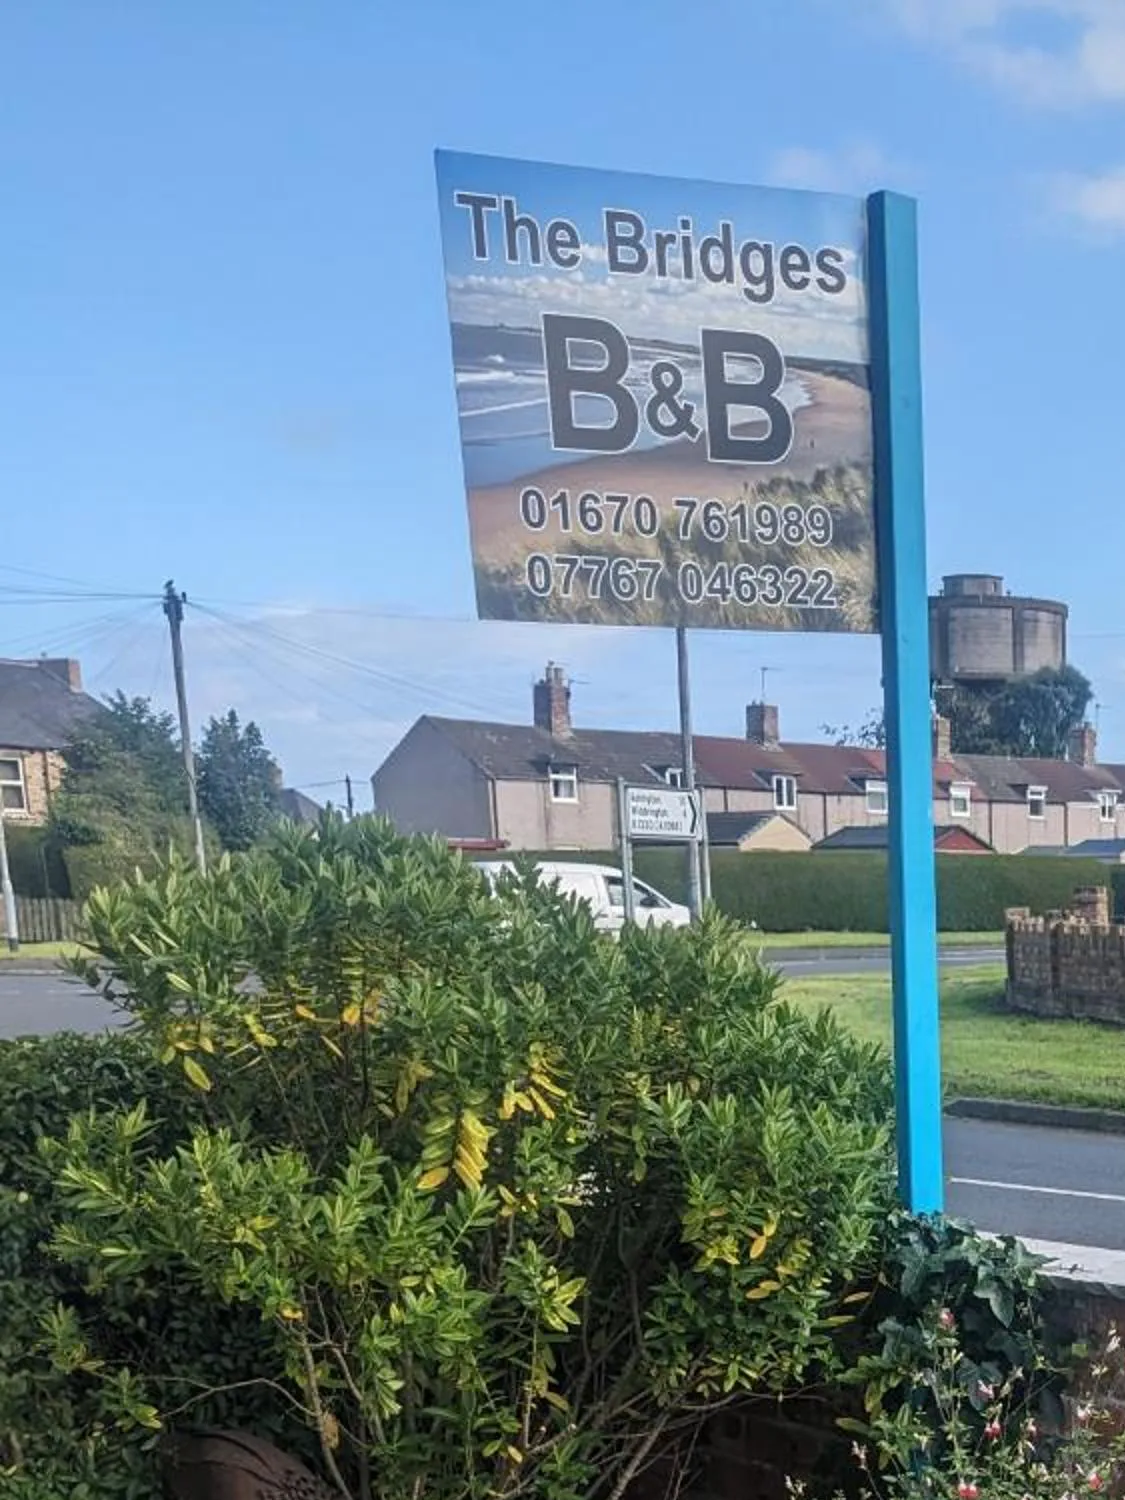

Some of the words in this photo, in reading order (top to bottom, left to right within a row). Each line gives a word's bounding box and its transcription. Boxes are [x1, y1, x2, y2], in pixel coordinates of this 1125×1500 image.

[454, 191, 581, 268] The
[603, 208, 847, 304] Bridges
[541, 312, 794, 465] B&B
[520, 488, 658, 537] 01670
[674, 498, 833, 546] 761989
[526, 554, 663, 600] 07767
[678, 562, 837, 608] 046322
